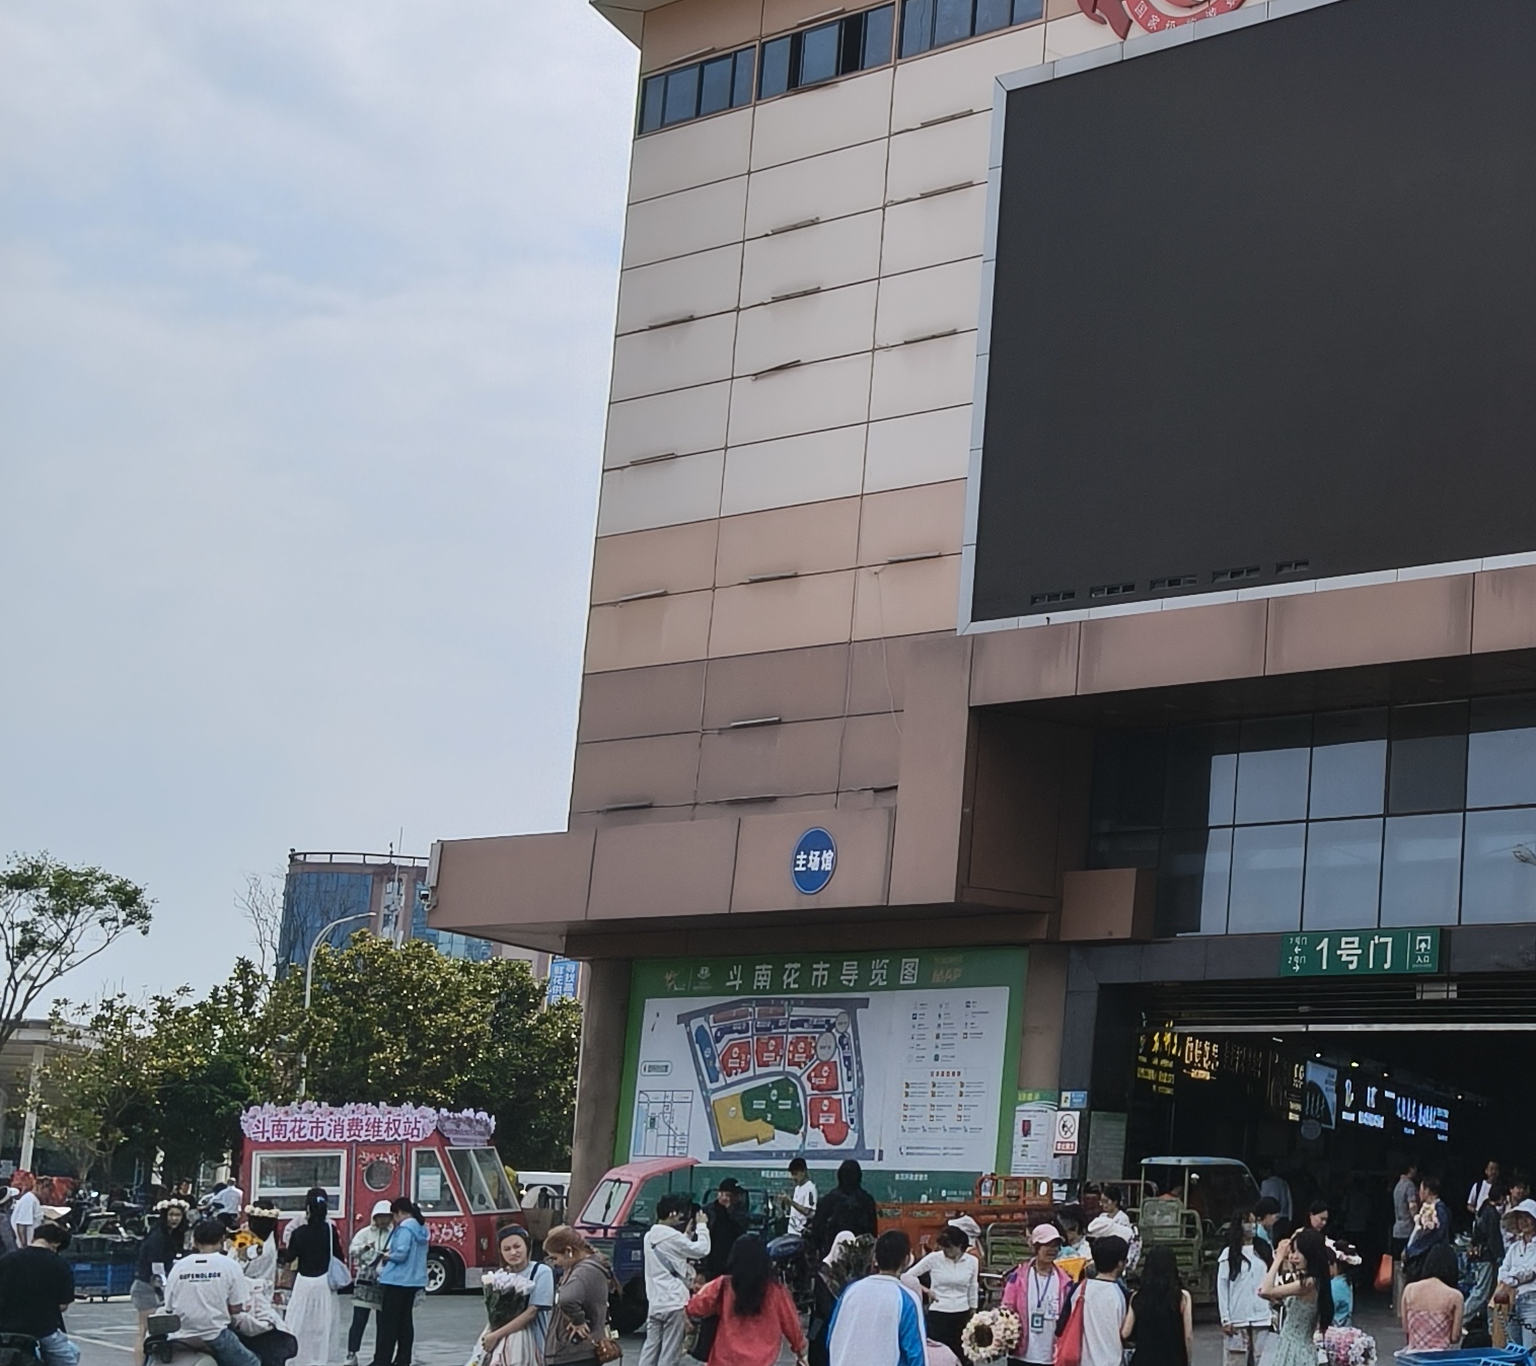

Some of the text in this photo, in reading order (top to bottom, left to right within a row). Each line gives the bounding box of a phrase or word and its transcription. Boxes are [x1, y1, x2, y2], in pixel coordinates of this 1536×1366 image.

[794, 849, 834, 872] 主场馆
[1316, 935, 1393, 970] 1号门
[1416, 955, 1430, 964] 入口
[725, 958, 919, 990] 斗南花市导览图
[251, 1115, 423, 1139] 斗南花市消费维权站
